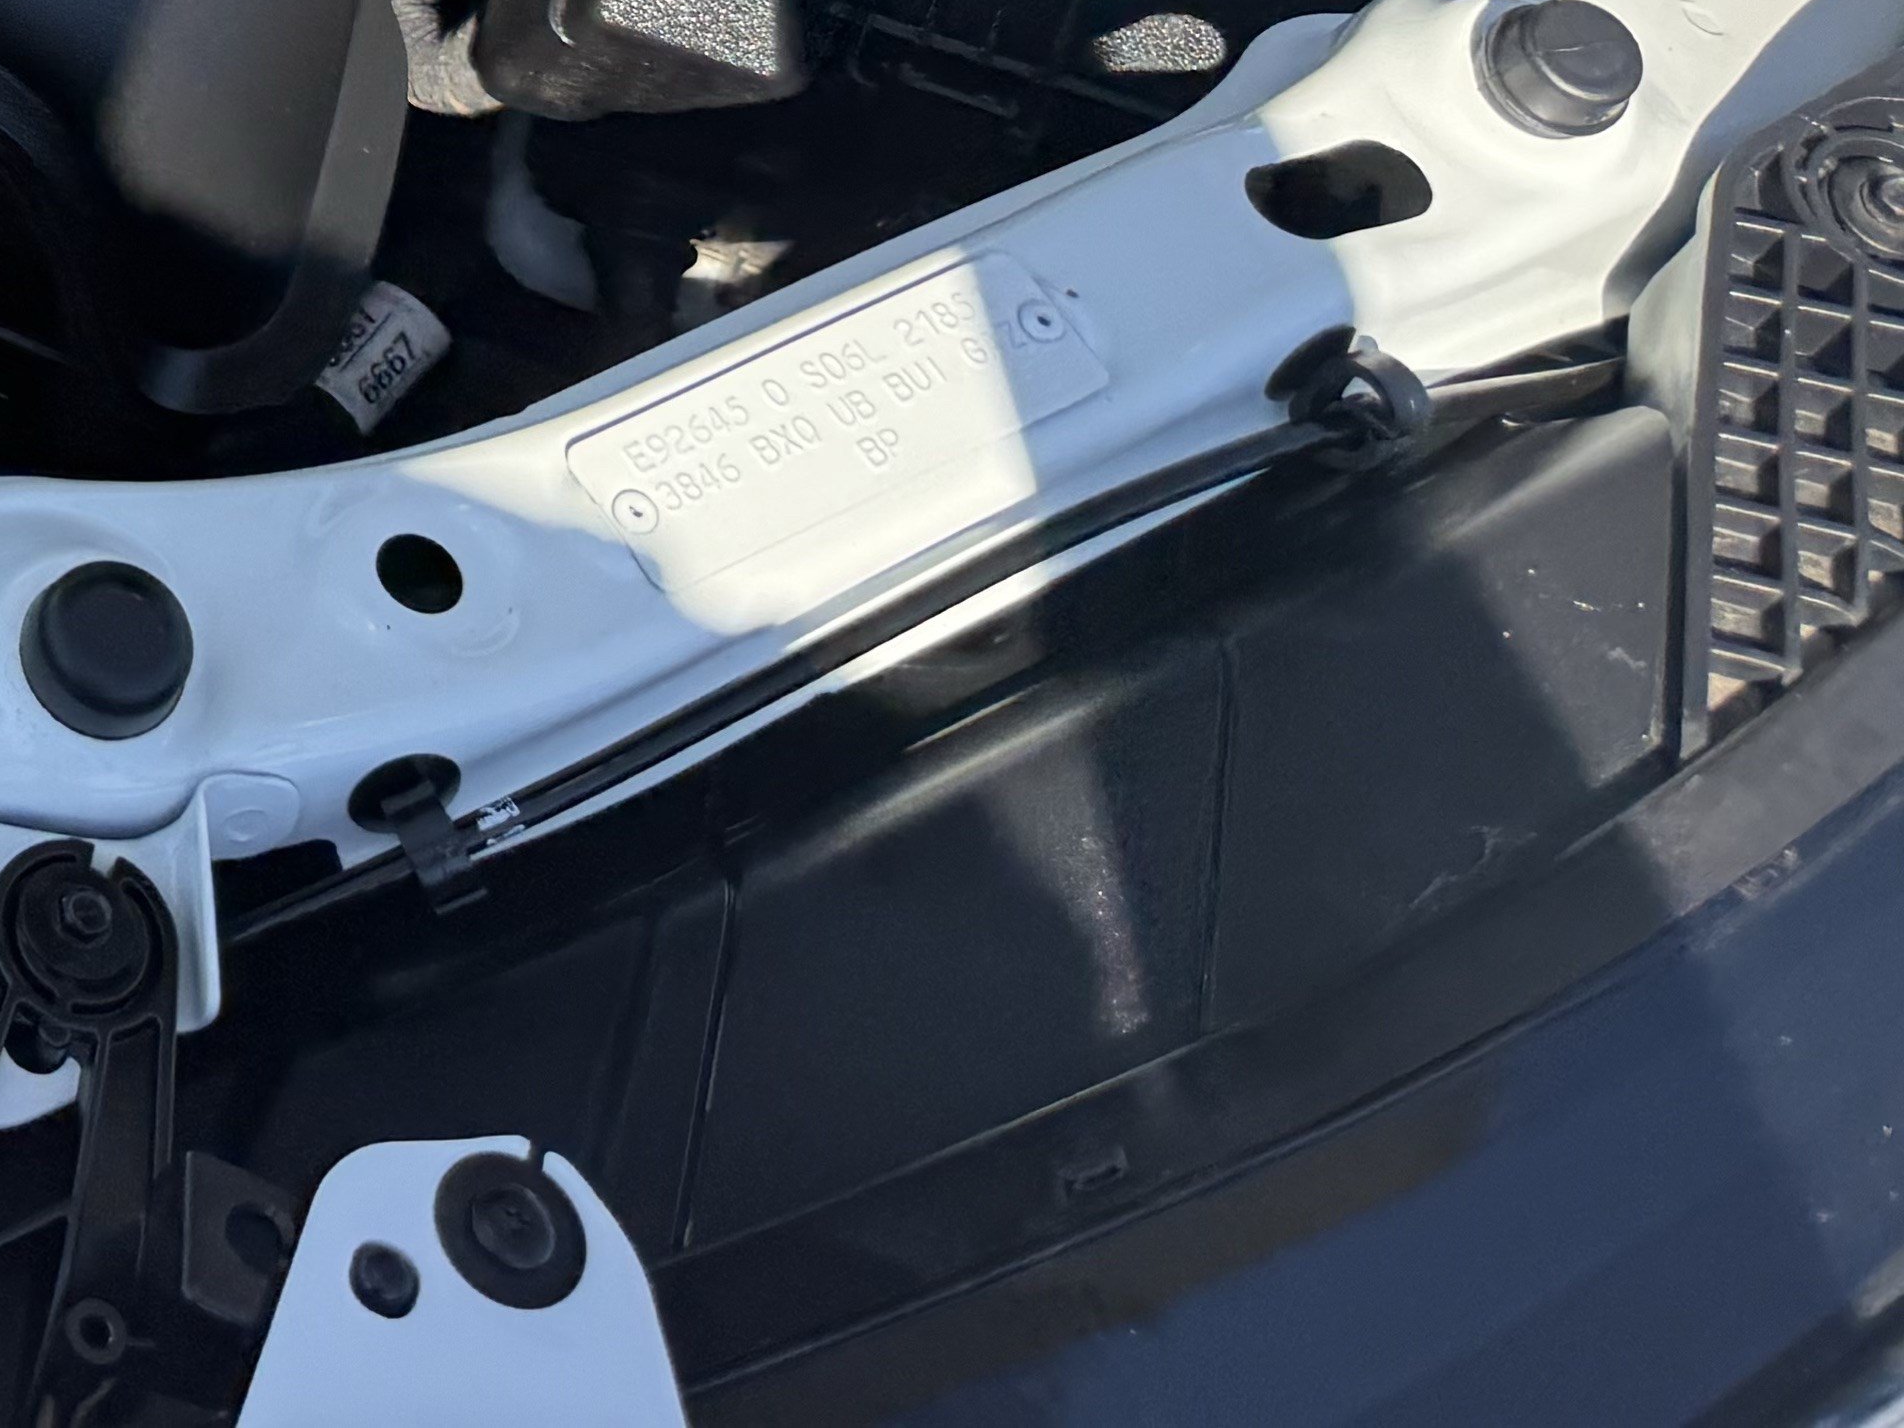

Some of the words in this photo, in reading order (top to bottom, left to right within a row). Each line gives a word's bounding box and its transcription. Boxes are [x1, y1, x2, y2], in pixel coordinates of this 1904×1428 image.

[654, 453, 741, 510] 3846
[827, 390, 877, 427] UB
[856, 427, 900, 469] BP
